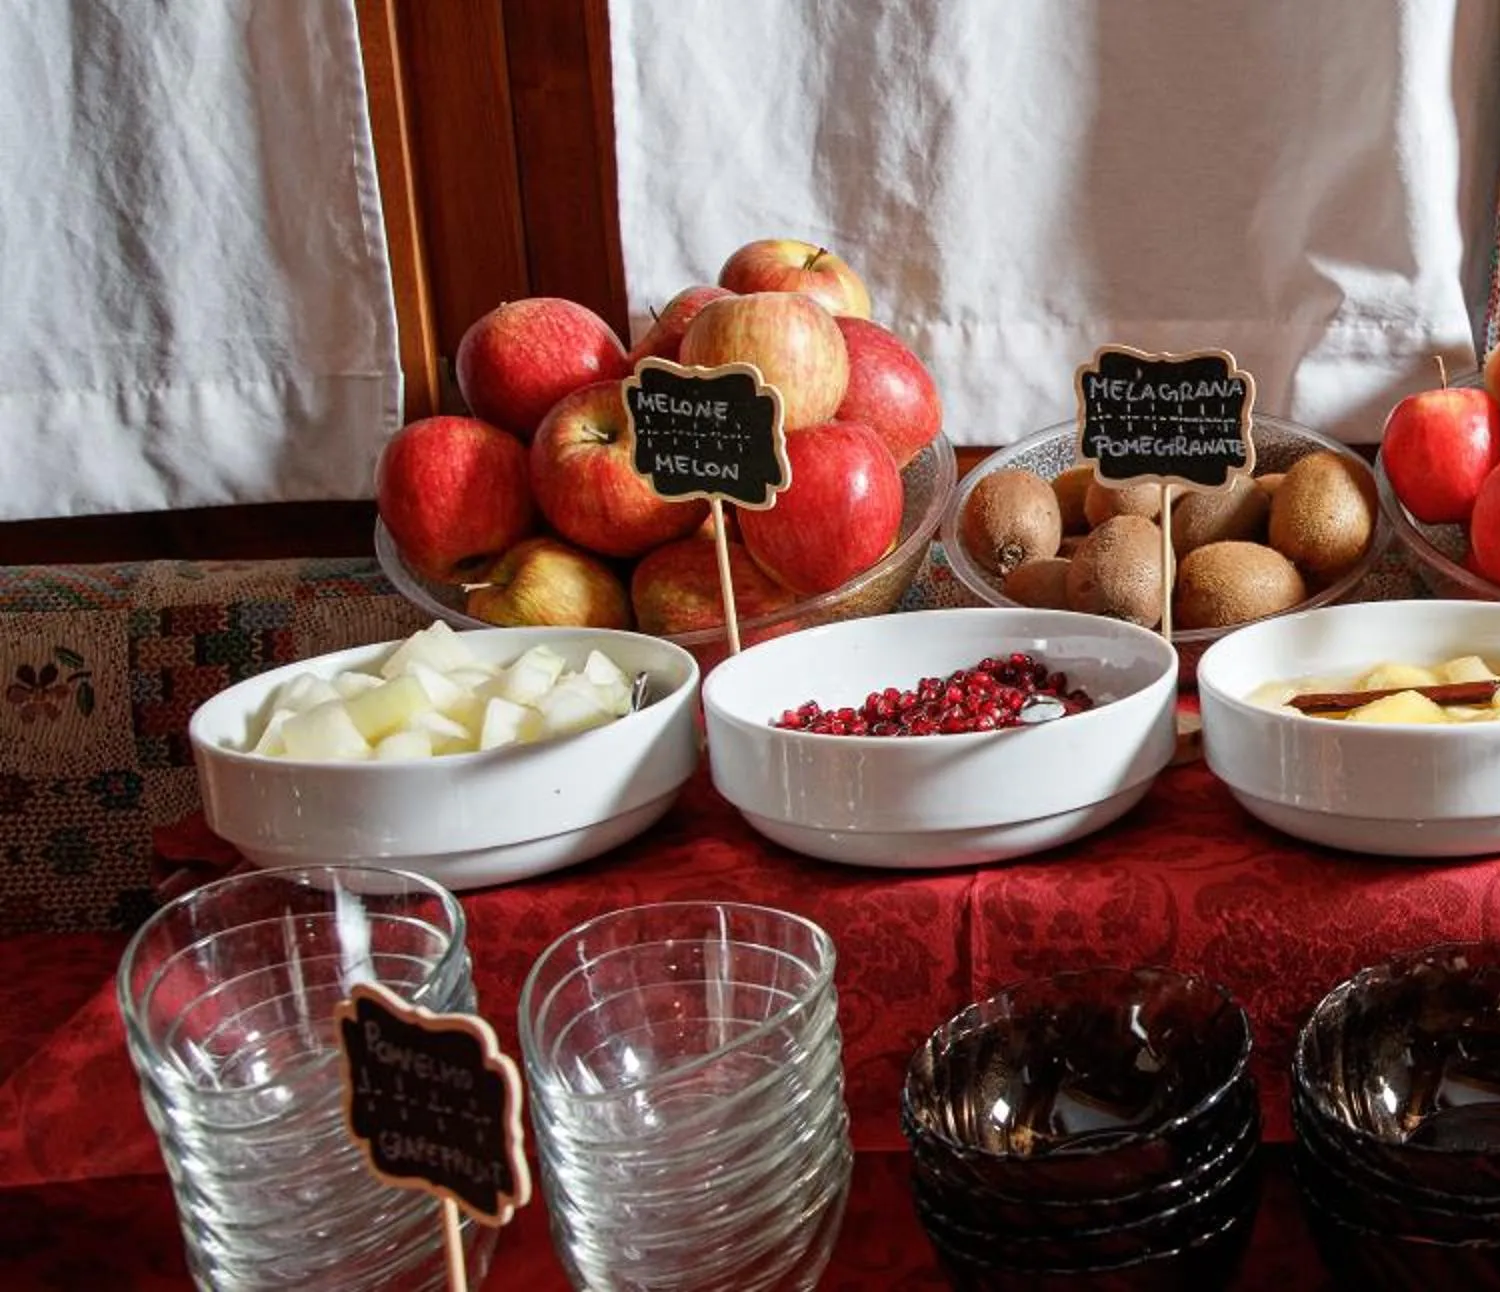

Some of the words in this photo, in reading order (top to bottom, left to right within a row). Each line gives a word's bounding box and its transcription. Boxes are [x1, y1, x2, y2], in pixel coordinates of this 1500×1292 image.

[1089, 377, 1243, 401] MELAGRANA
[637, 391, 729, 420] MELONE
[1090, 434, 1246, 457] POMEGRANATE
[655, 453, 739, 481] MELON
